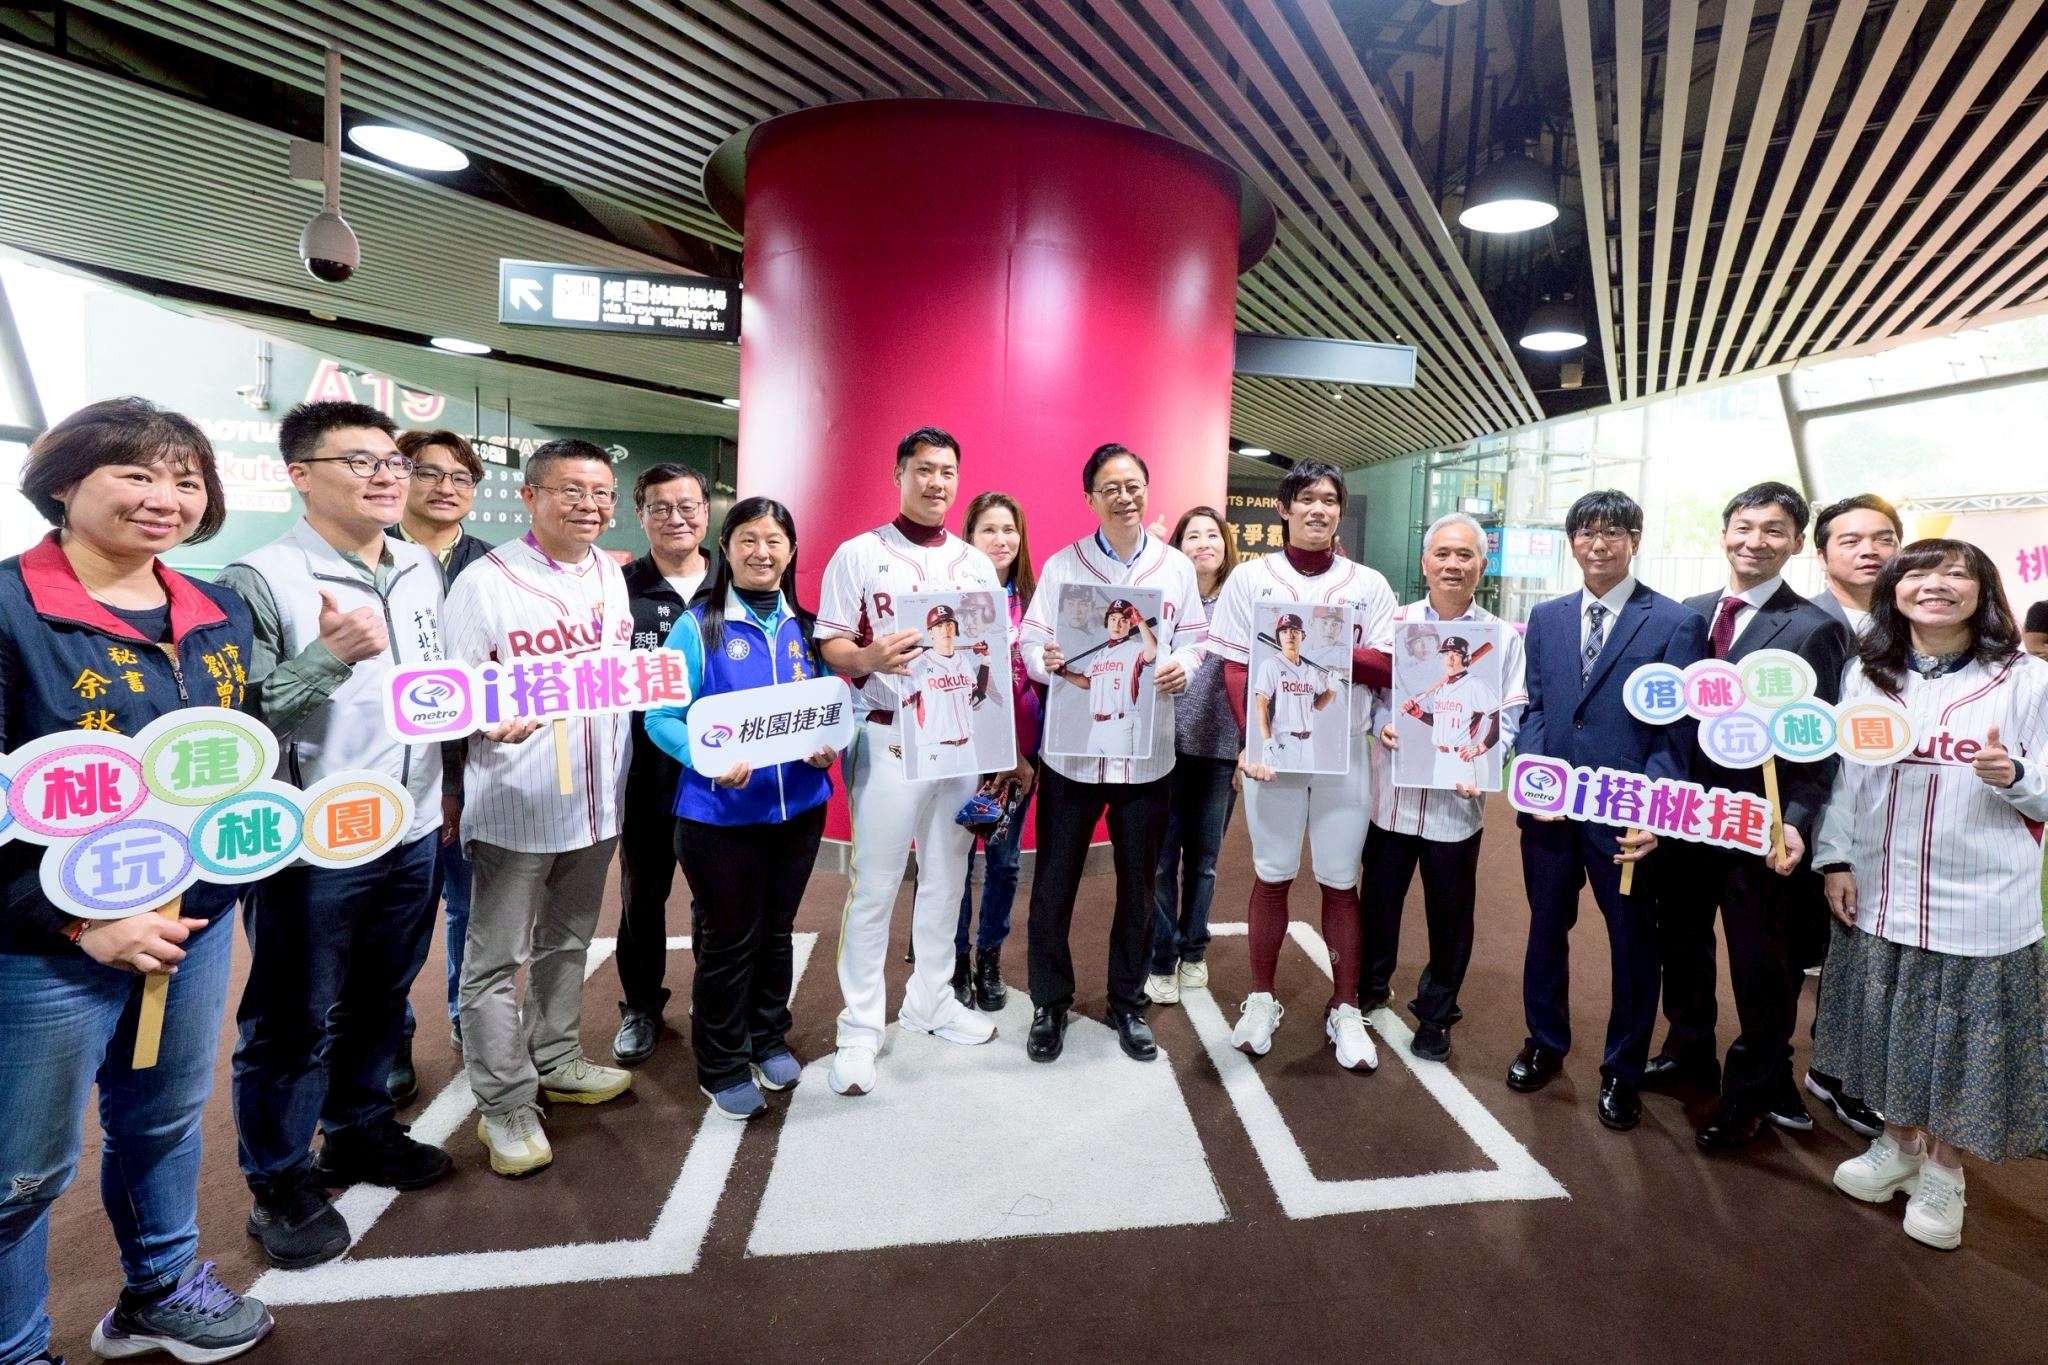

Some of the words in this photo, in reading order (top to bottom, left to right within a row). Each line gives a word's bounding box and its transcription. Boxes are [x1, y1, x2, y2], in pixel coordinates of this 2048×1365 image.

[624, 303, 673, 318] Taoyuan
[677, 307, 718, 321] Airport
[303, 358, 446, 423] A19
[223, 453, 288, 482] kute
[499, 471, 508, 482] 9
[512, 471, 524, 482] 10
[1246, 496, 1278, 508] PARK
[657, 605, 672, 632] 特助
[508, 615, 632, 658] Rakuen
[107, 647, 146, 693] 秘書
[927, 673, 971, 691] Rakute
[1113, 678, 1121, 691] 5
[1281, 680, 1315, 696] Rakute
[72, 668, 122, 734] 余秋
[412, 708, 458, 722] metro
[738, 701, 843, 744] 桃園捷運
[1451, 717, 1461, 730] 11
[1914, 731, 1985, 764] ute
[1523, 789, 1555, 802] metro
